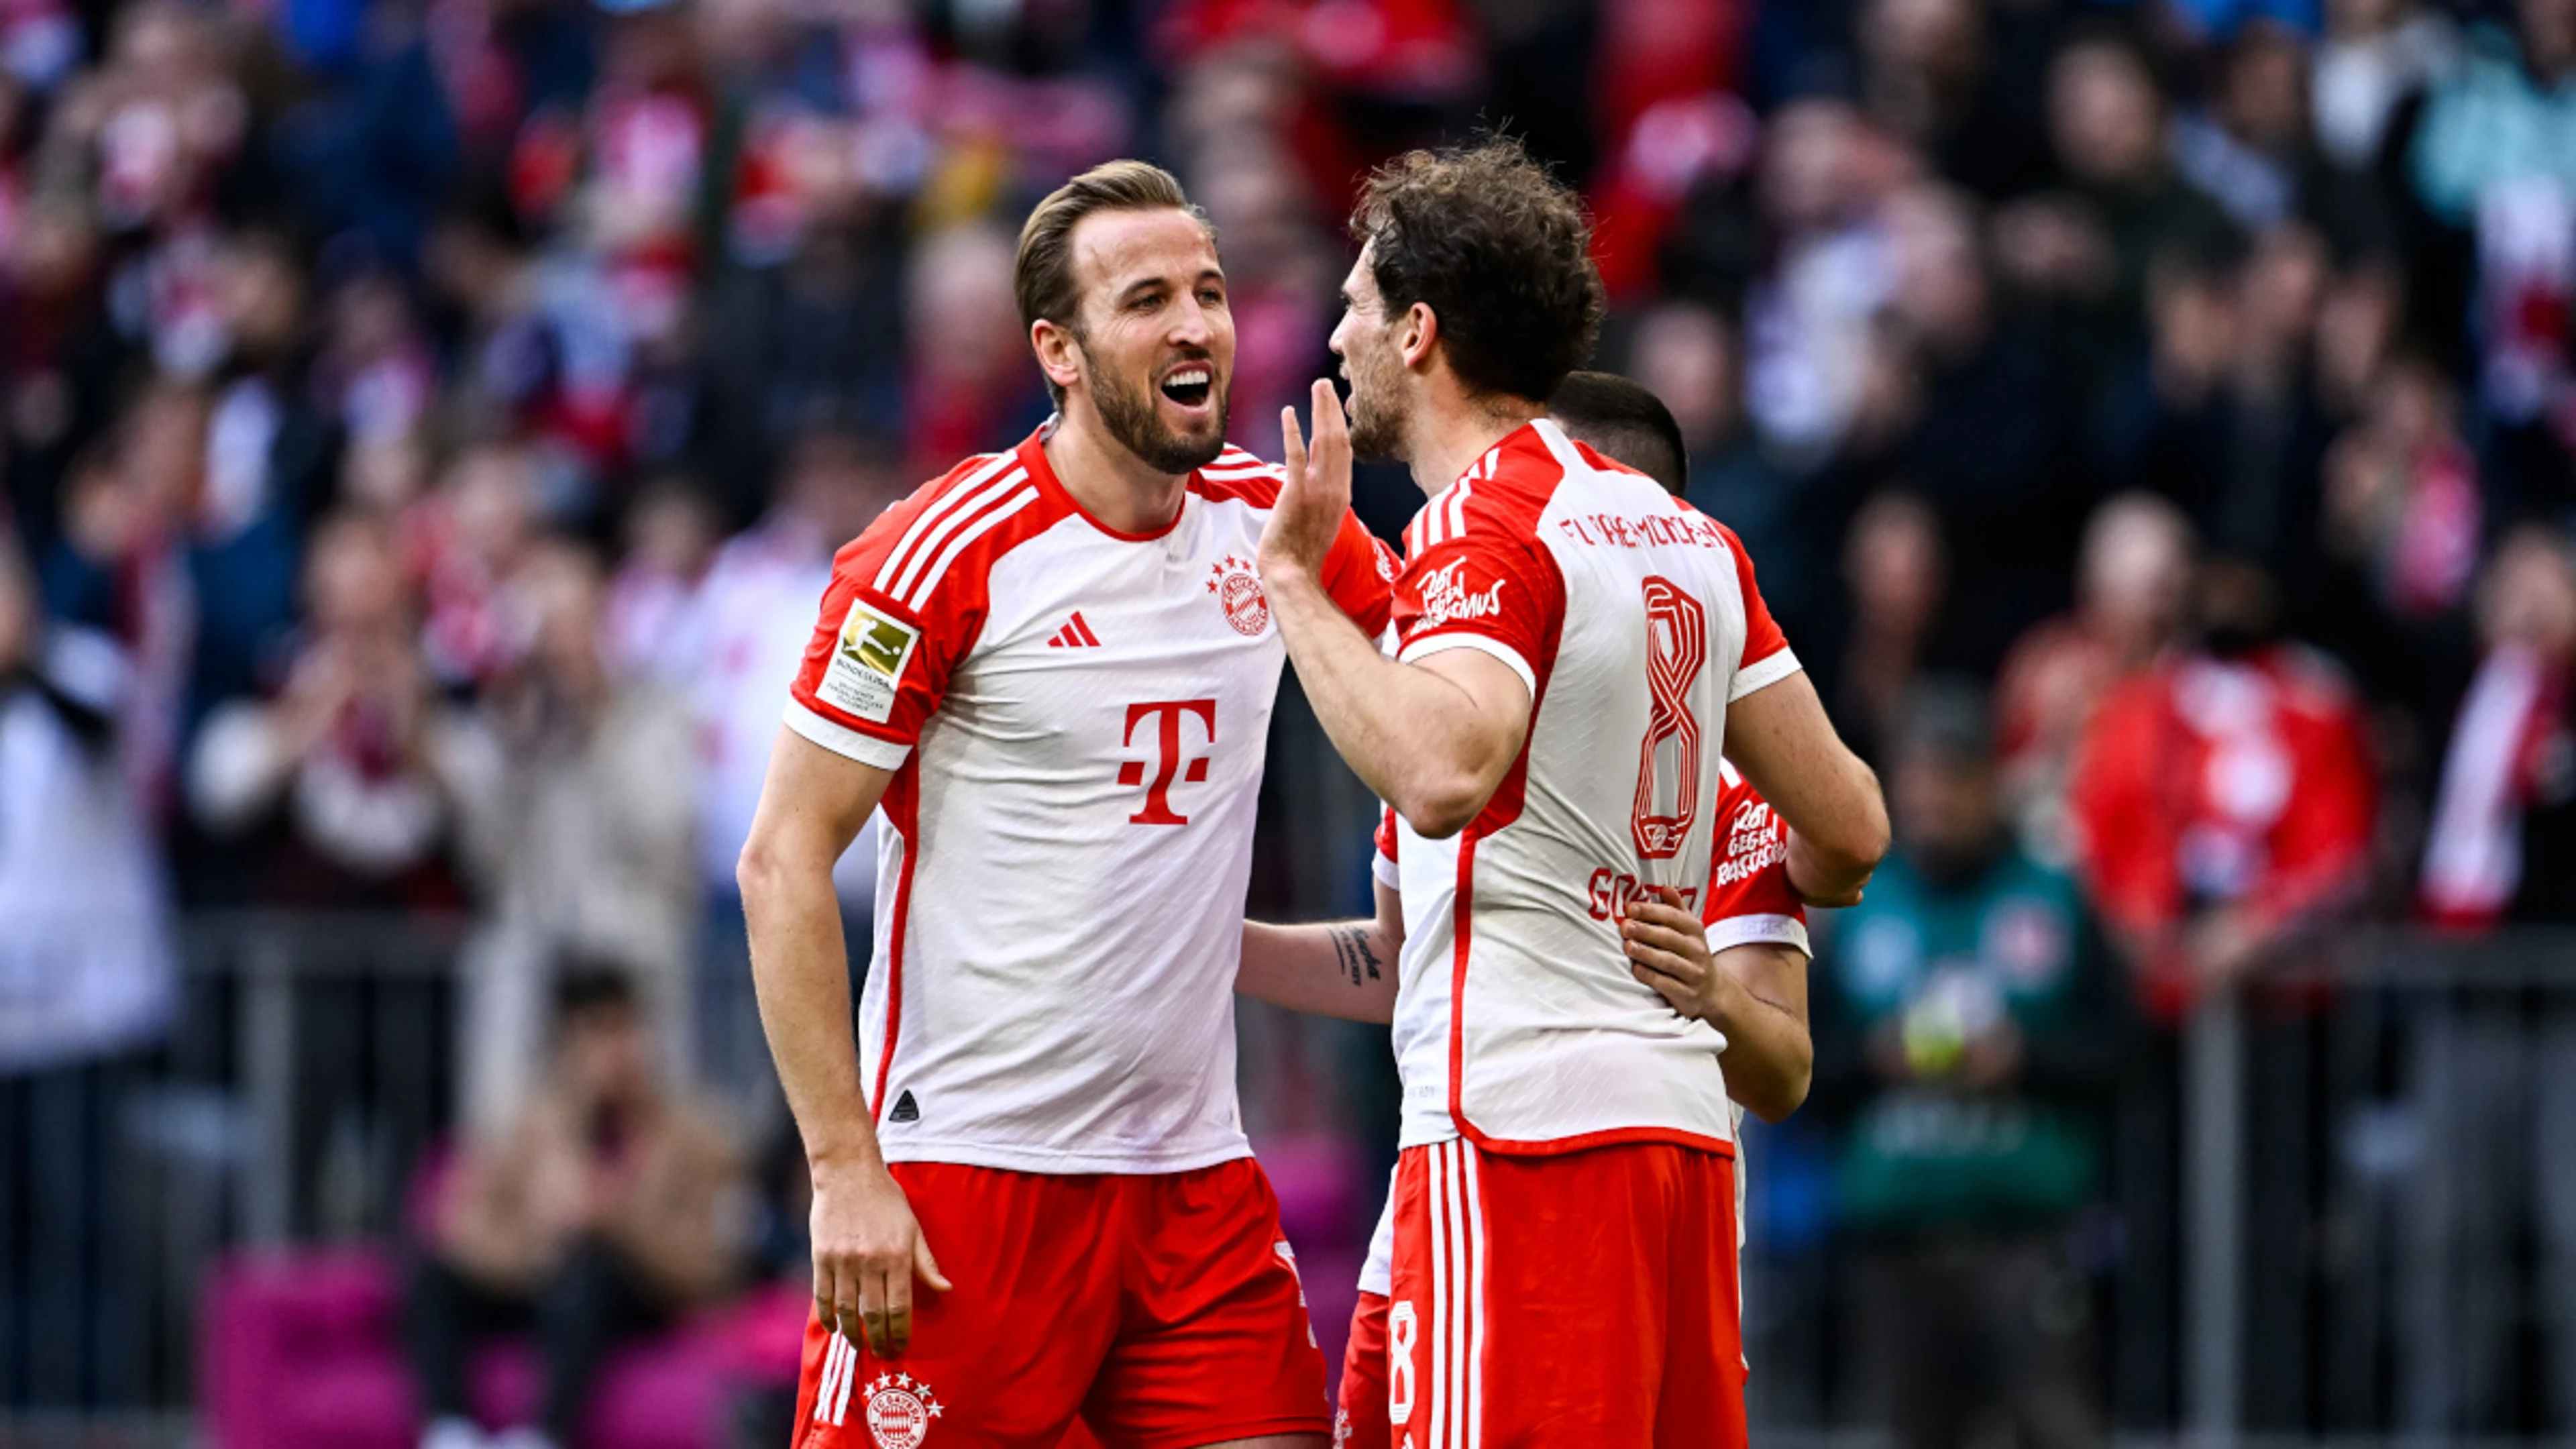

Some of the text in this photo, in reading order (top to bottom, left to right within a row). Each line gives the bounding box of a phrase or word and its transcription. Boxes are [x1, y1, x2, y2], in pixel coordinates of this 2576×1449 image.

[1117, 698, 1216, 825] T
[1631, 575, 1706, 859] 8
[1727, 814, 1778, 857] GEGEN
[1389, 1299, 1417, 1424] 8
